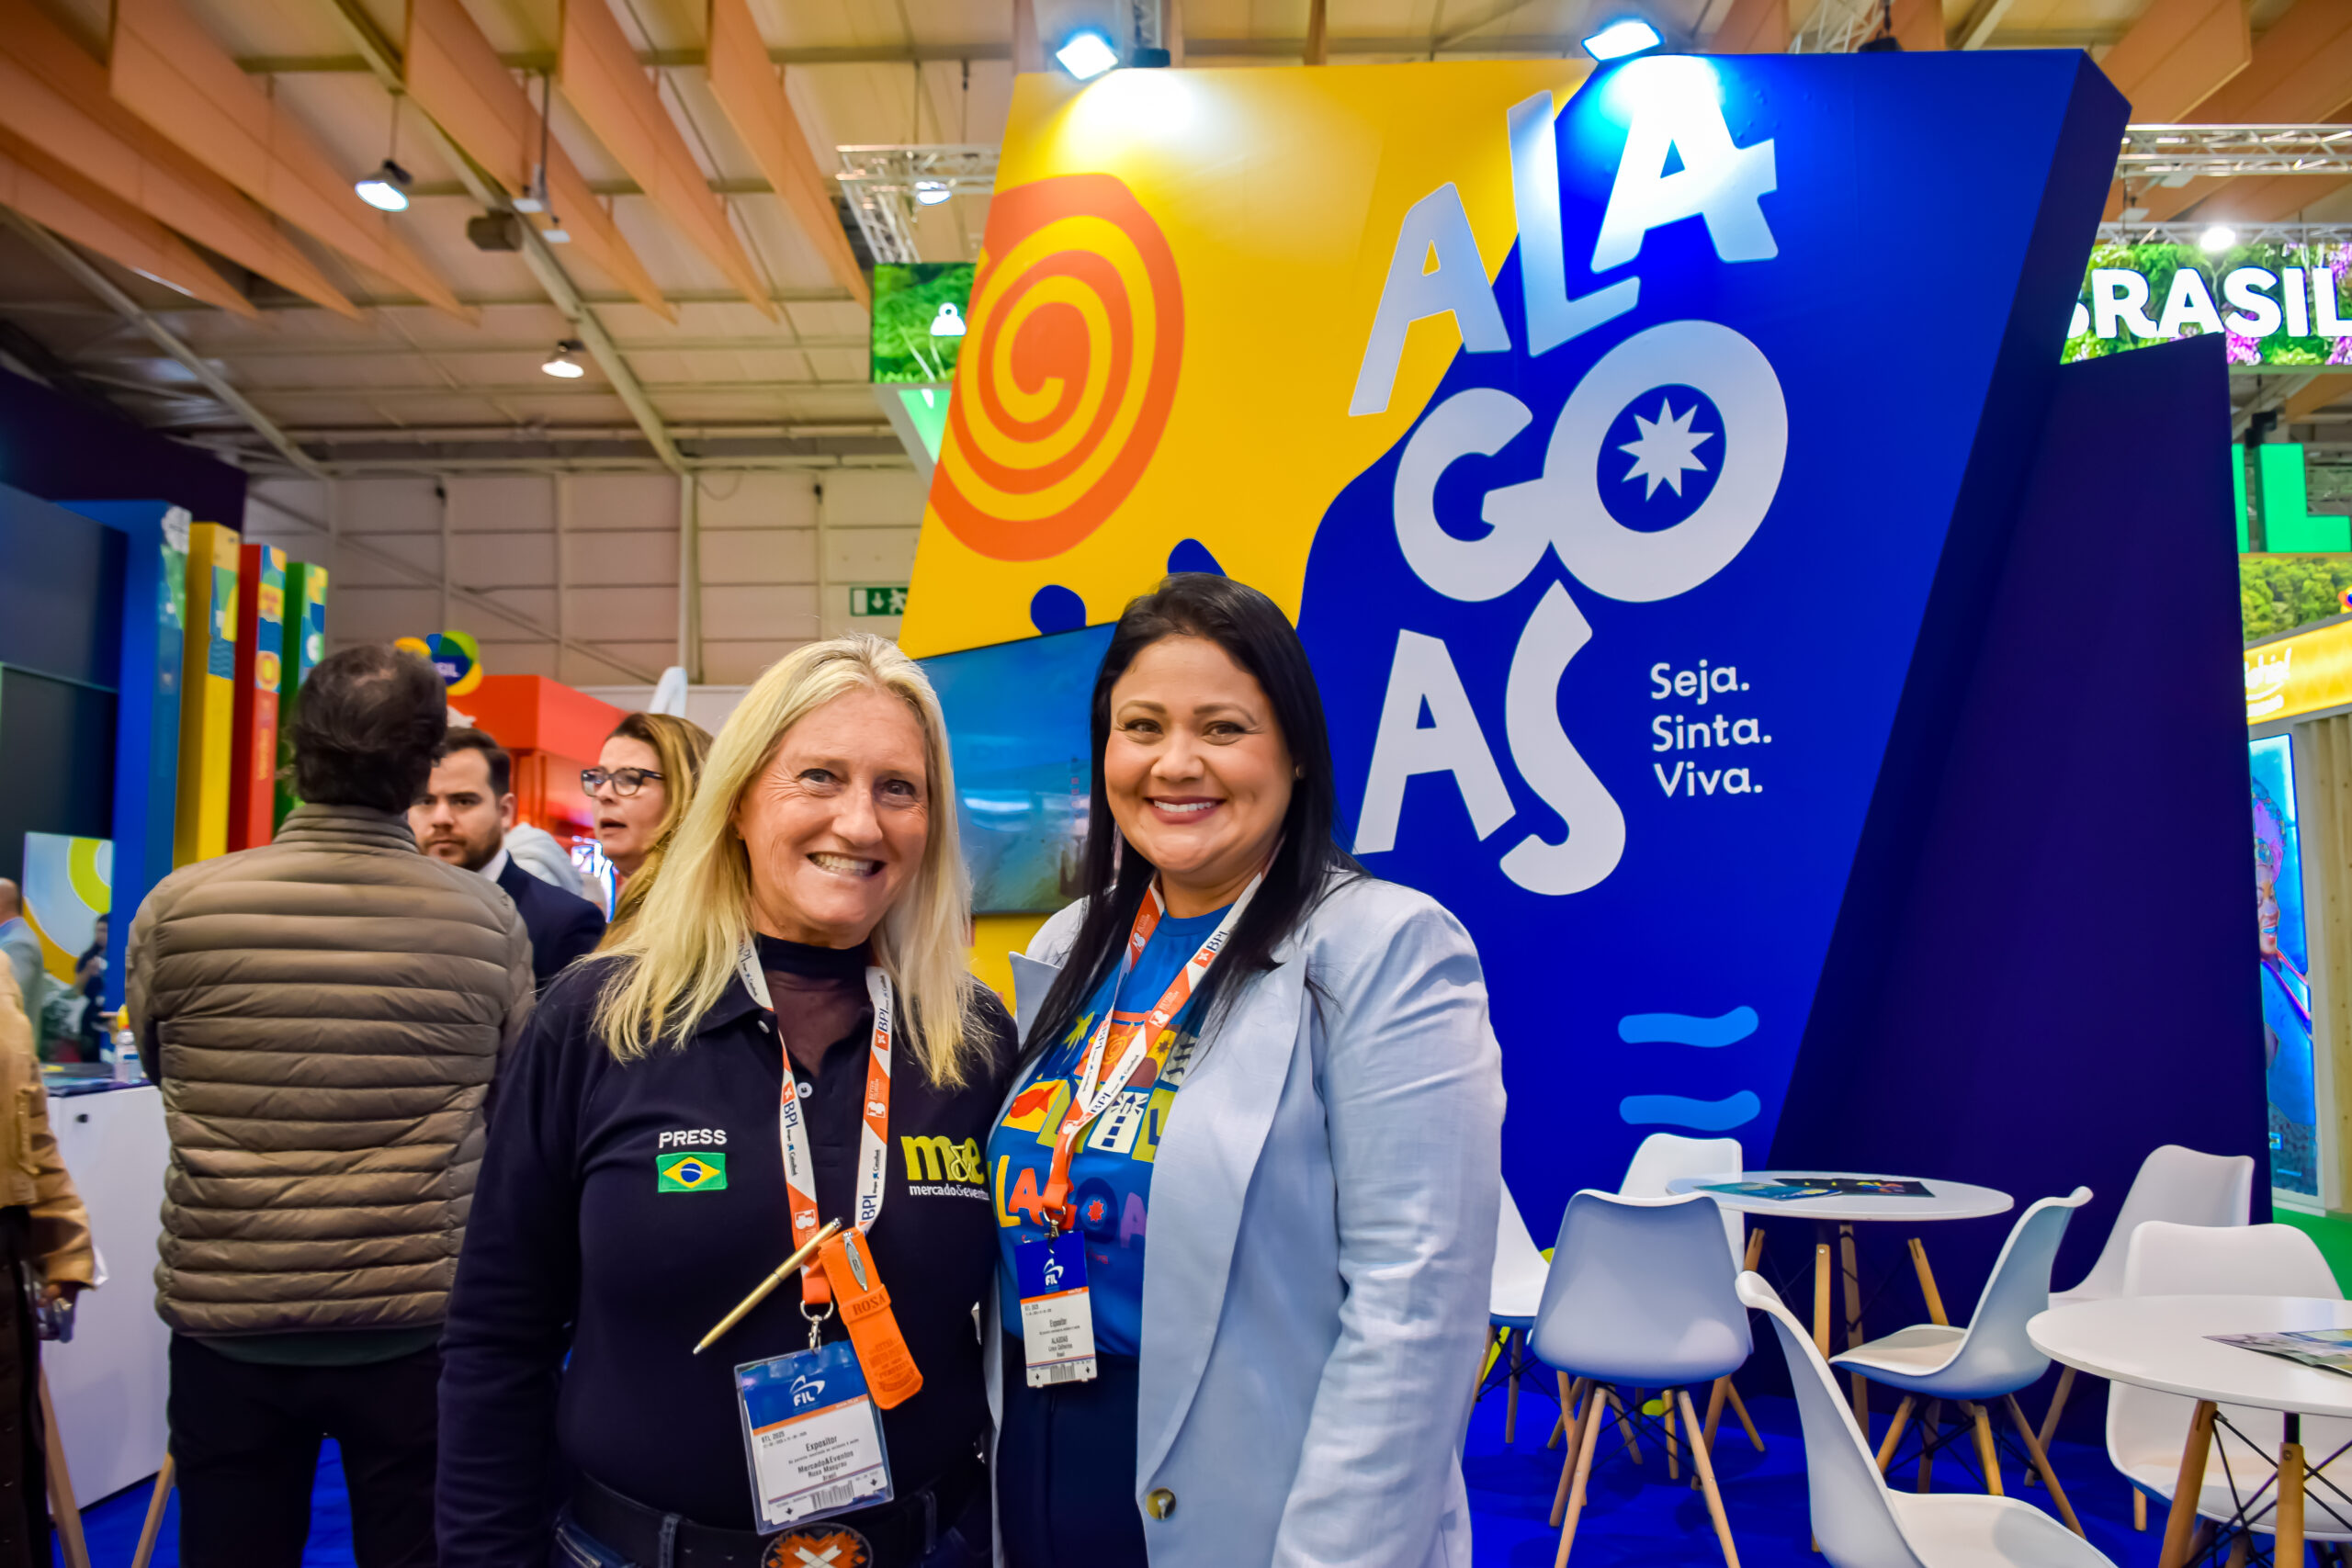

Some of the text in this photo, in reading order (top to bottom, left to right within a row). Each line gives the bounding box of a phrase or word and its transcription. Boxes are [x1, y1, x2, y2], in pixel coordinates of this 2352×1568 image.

[1650, 659, 1750, 705] Seja.
[1651, 714, 1772, 752] Sinta.
[1654, 761, 1763, 797] Viva.
[1206, 931, 1228, 952] BPI
[878, 1008, 889, 1032] BPI
[784, 1101, 798, 1129] BPI
[658, 1128, 728, 1149] PRESS
[900, 1135, 985, 1185] m&e
[862, 1194, 876, 1221] BPI
[852, 1294, 888, 1315] ROSA
[793, 1393, 816, 1406] FIL
[806, 1436, 837, 1452] Expositor
[797, 1450, 854, 1473] Mercado&Eventos
